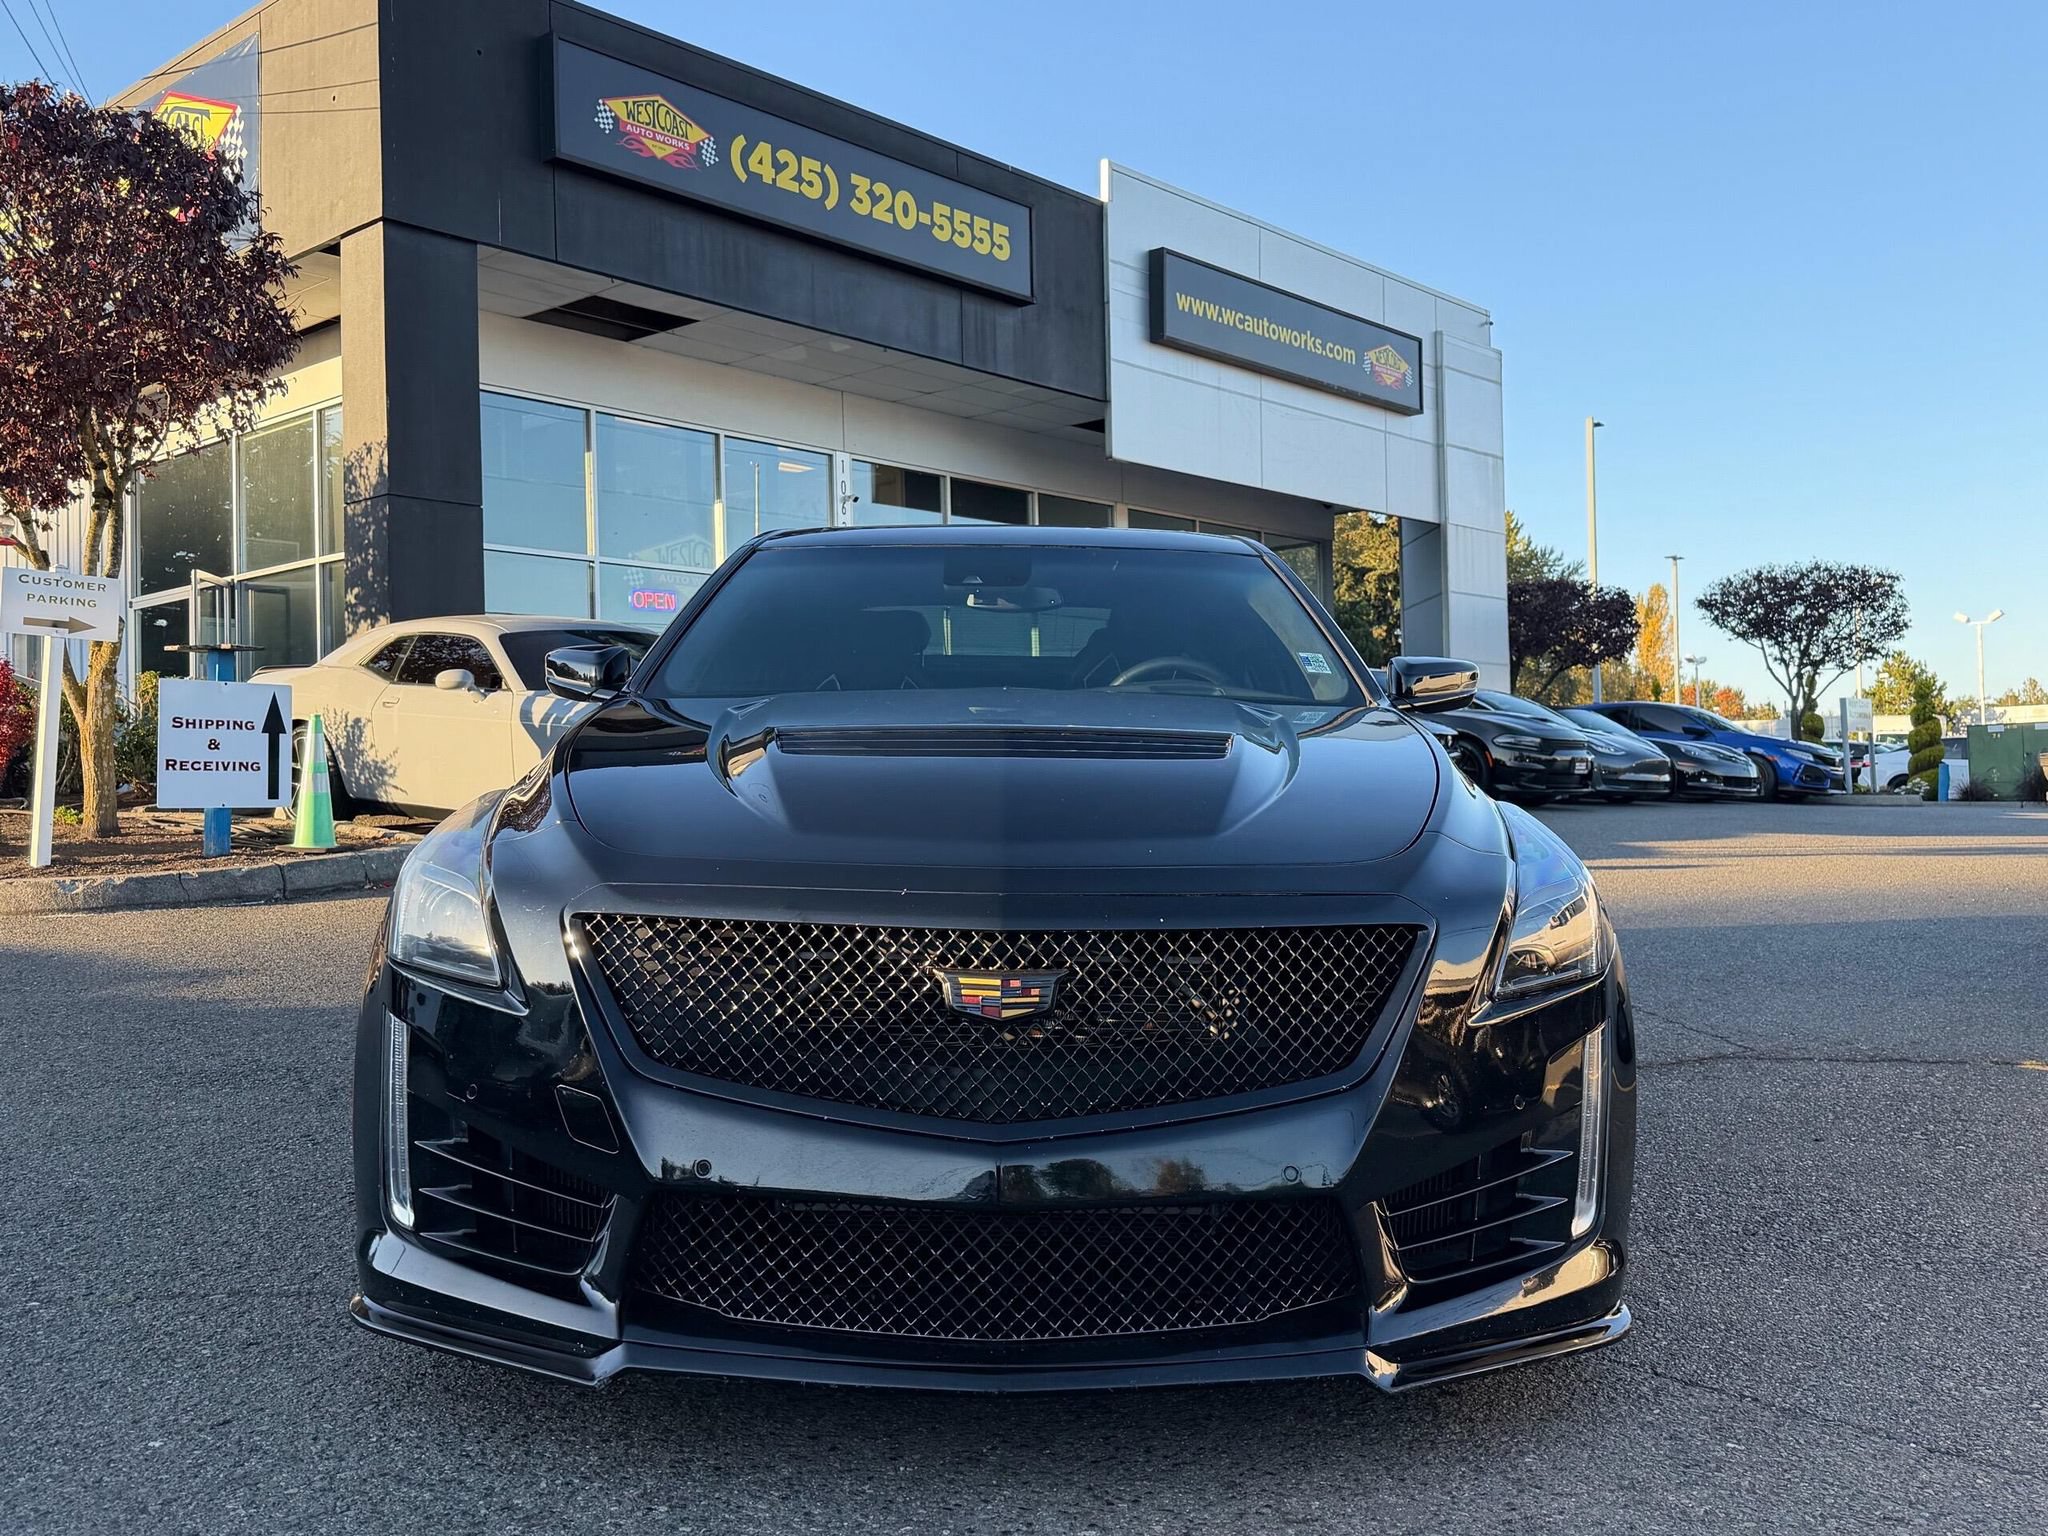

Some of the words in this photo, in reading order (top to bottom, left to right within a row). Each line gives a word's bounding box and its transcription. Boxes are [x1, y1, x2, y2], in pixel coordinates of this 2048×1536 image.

[626, 123, 654, 139] AUTO
[655, 132, 690, 151] WORKS
[730, 134, 840, 211] (425)
[849, 173, 1011, 262] 320-5555
[1176, 292, 1356, 365] www.wcautoworks.com
[18, 574, 107, 592] CUSTOMER
[26, 593, 97, 608] PARKING
[633, 591, 676, 610] OPEN
[171, 716, 255, 731] SHIPPING
[207, 738, 220, 751] &
[165, 759, 261, 772] RECEIVING
